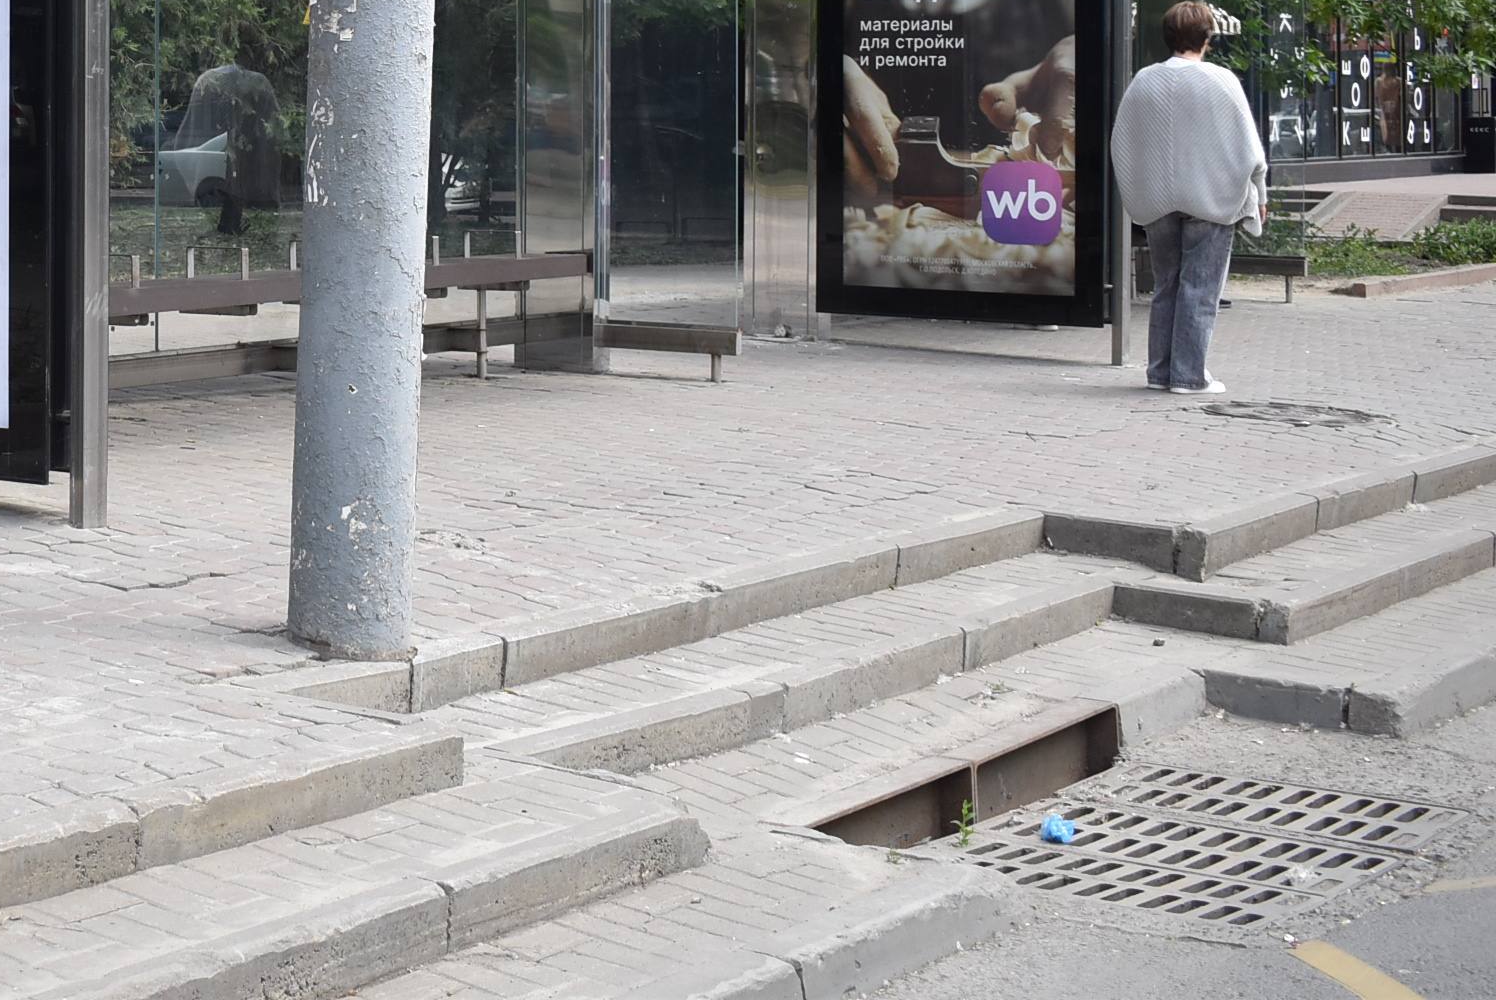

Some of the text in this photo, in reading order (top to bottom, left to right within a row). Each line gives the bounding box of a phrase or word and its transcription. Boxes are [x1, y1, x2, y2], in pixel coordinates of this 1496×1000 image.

[860, 19, 953, 34] материалы
[859, 34, 965, 52] для стройки
[860, 55, 947, 69] и ремонта
[986, 179, 1057, 221] wb
